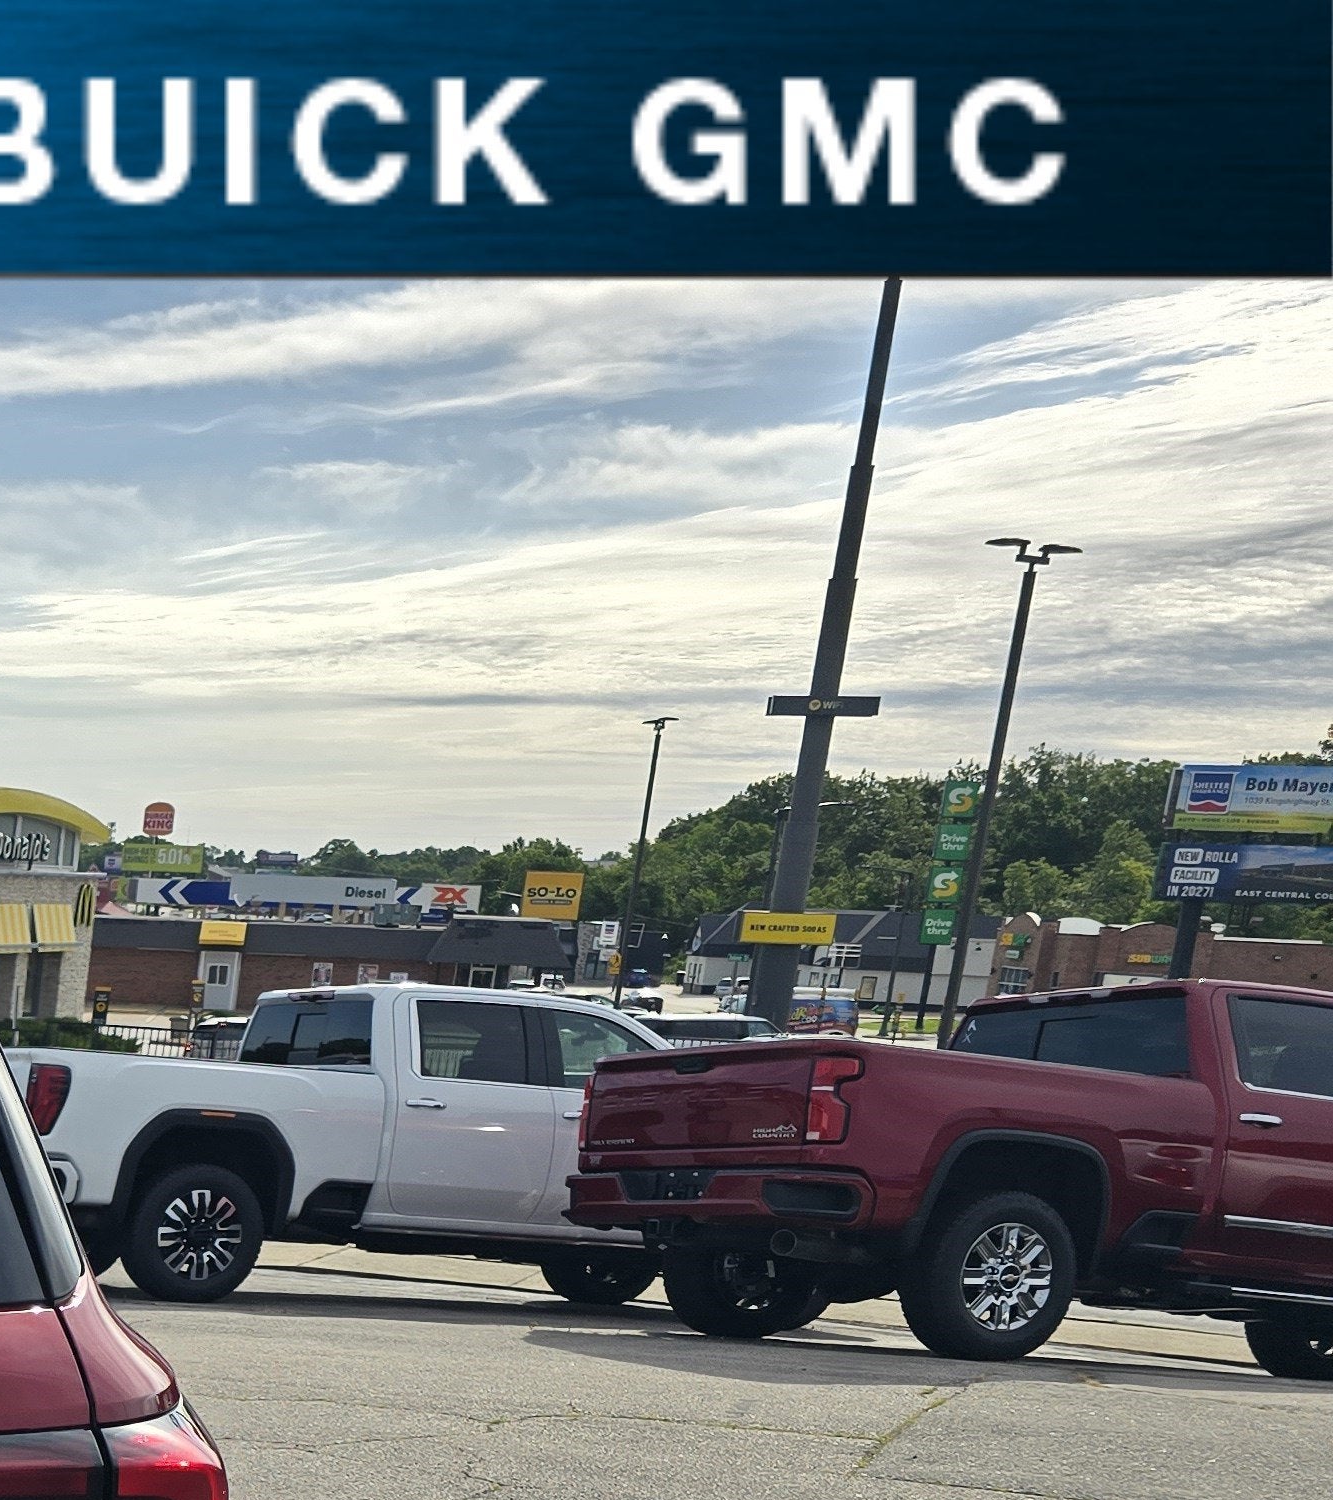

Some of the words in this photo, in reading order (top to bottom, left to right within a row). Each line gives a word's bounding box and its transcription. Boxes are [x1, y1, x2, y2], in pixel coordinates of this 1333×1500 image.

[1194, 781, 1230, 789] SHELTER
[1245, 777, 1278, 791] Bob
[144, 820, 173, 829] KING
[940, 834, 968, 843] Drive
[943, 842, 964, 850] thru
[1177, 852, 1200, 862] NEW
[1205, 852, 1238, 863] ROLLA
[1174, 870, 1215, 882] FACILITY
[345, 886, 386, 898] Diesel
[527, 887, 577, 898] SO-LO
[1167, 885, 1179, 896] IN
[1235, 889, 1261, 897] EAST
[1265, 891, 1310, 899] CENTRAL
[925, 918, 952, 927] Drive
[927, 927, 949, 935] thru
[1127, 954, 1172, 963] SUBWA
